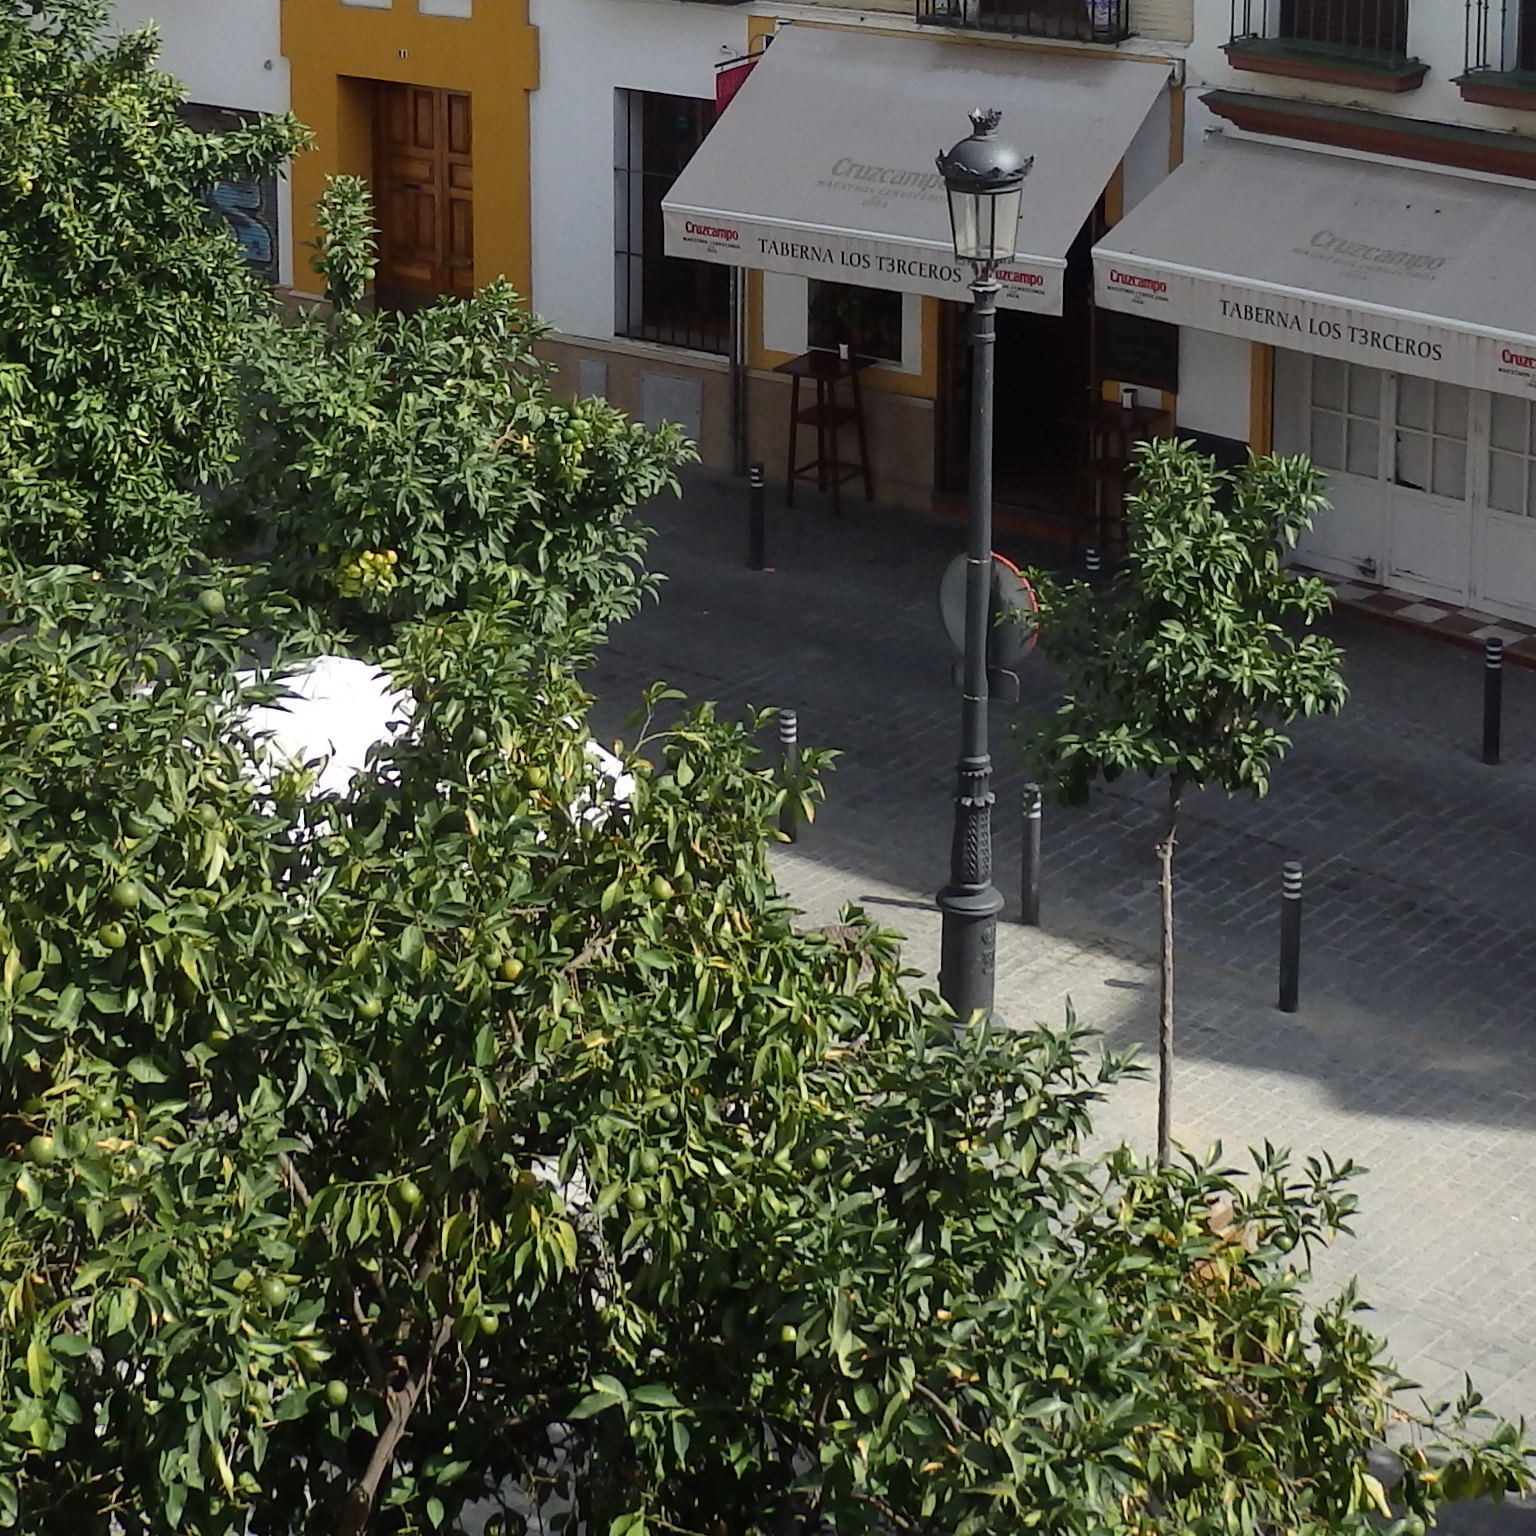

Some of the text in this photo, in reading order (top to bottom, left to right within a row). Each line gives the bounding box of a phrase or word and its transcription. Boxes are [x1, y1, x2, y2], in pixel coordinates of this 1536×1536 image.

[685, 221, 739, 241] Cruzcampo
[1310, 229, 1446, 270] Cruzcampo
[757, 238, 834, 264] TABERNA
[840, 250, 871, 269] LOS
[876, 255, 962, 283] T3RCEROS
[1110, 269, 1167, 293] Cruzcampo
[1219, 300, 1443, 361] TABERNA LOS T3RCEROS
